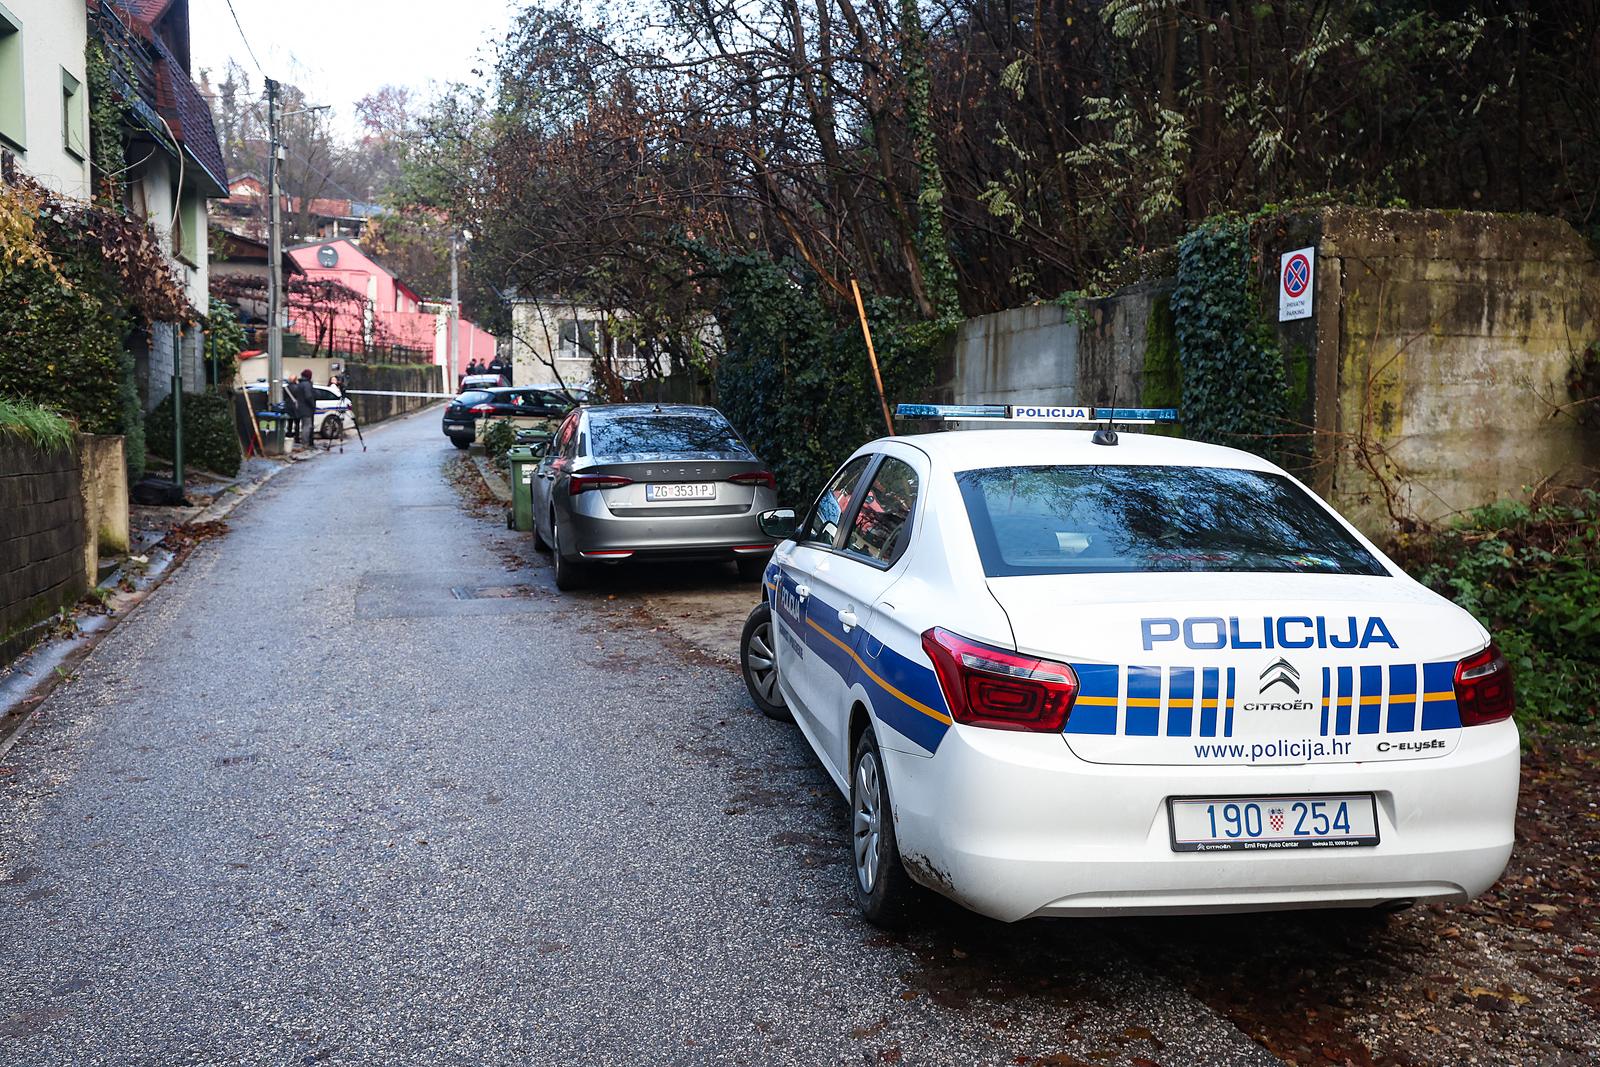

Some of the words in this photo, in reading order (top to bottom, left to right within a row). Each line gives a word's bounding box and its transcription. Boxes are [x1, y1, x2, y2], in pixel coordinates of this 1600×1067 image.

[1016, 408, 1086, 419] POLICIJA
[654, 486, 668, 498] ZG
[1140, 615, 1400, 650] POLICIJA
[1243, 699, 1314, 711] CITROËN
[1194, 738, 1352, 762] www.policija.hr
[1206, 802, 1263, 838] 190
[1292, 801, 1351, 836] 254
[1256, 842, 1268, 850] Frey
